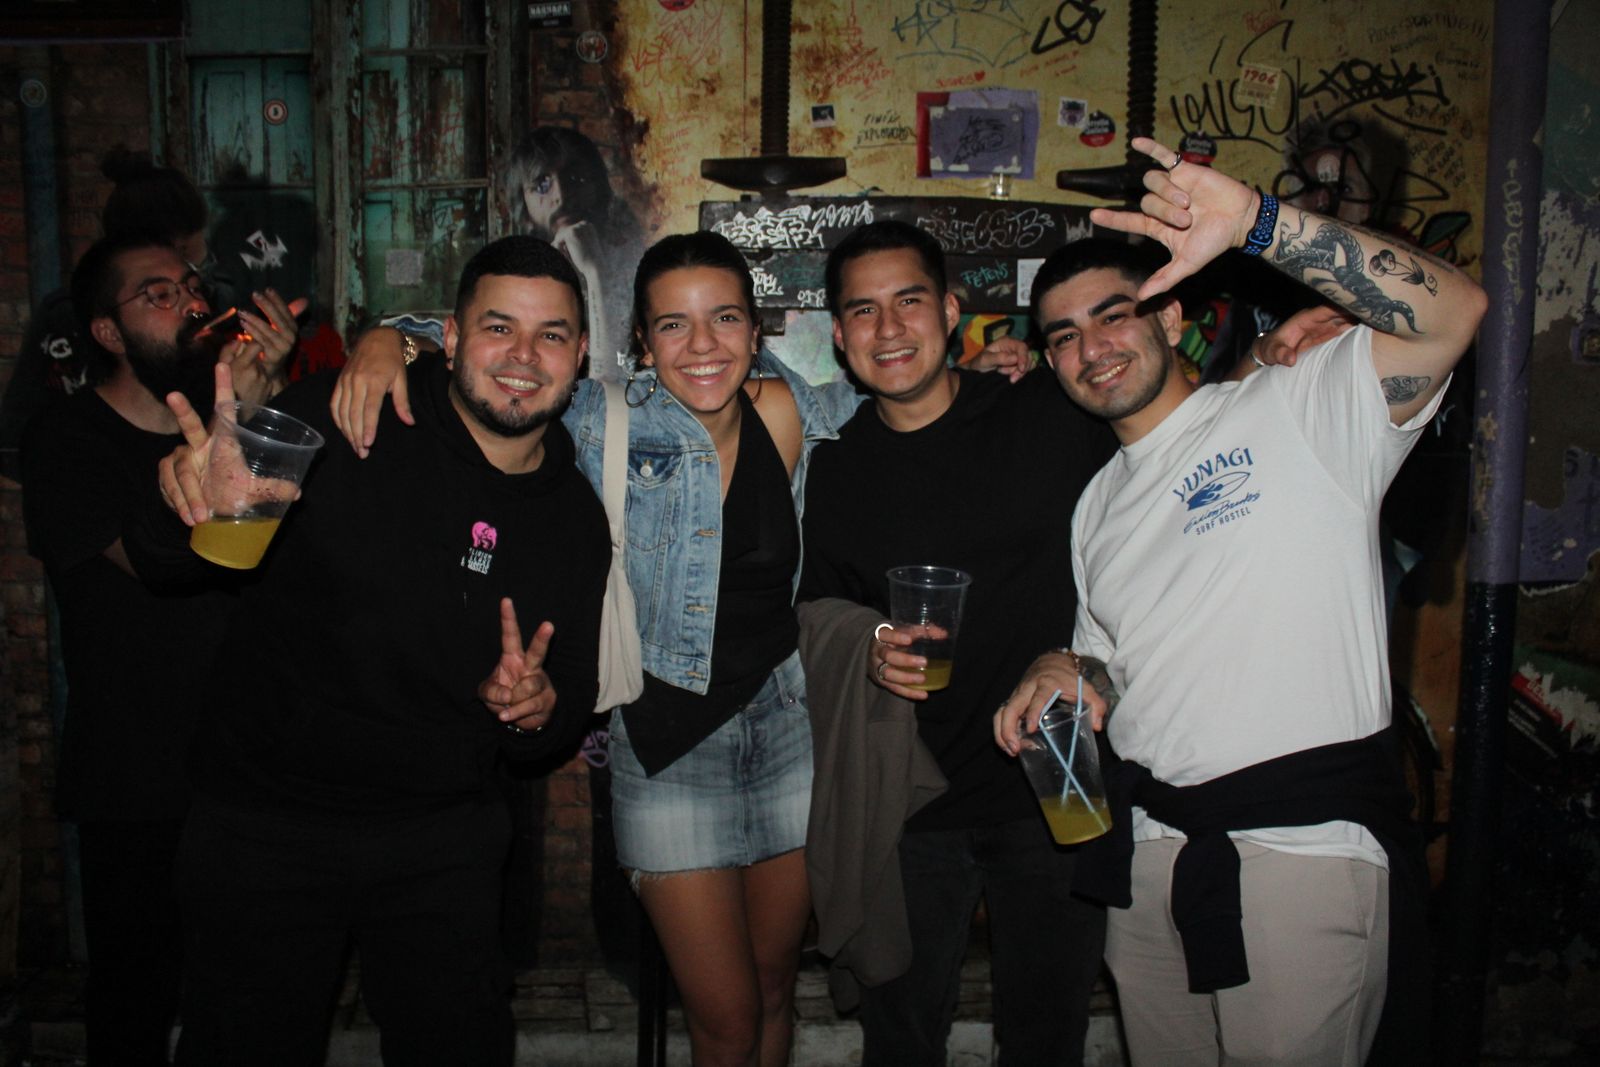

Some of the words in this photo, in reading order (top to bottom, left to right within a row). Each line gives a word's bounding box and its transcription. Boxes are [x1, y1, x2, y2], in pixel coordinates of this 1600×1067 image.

[1244, 69, 1278, 85] 1906
[1173, 448, 1253, 502] YUNAGI
[1196, 519, 1217, 536] SURF
[1219, 506, 1251, 525] HOSTEL
